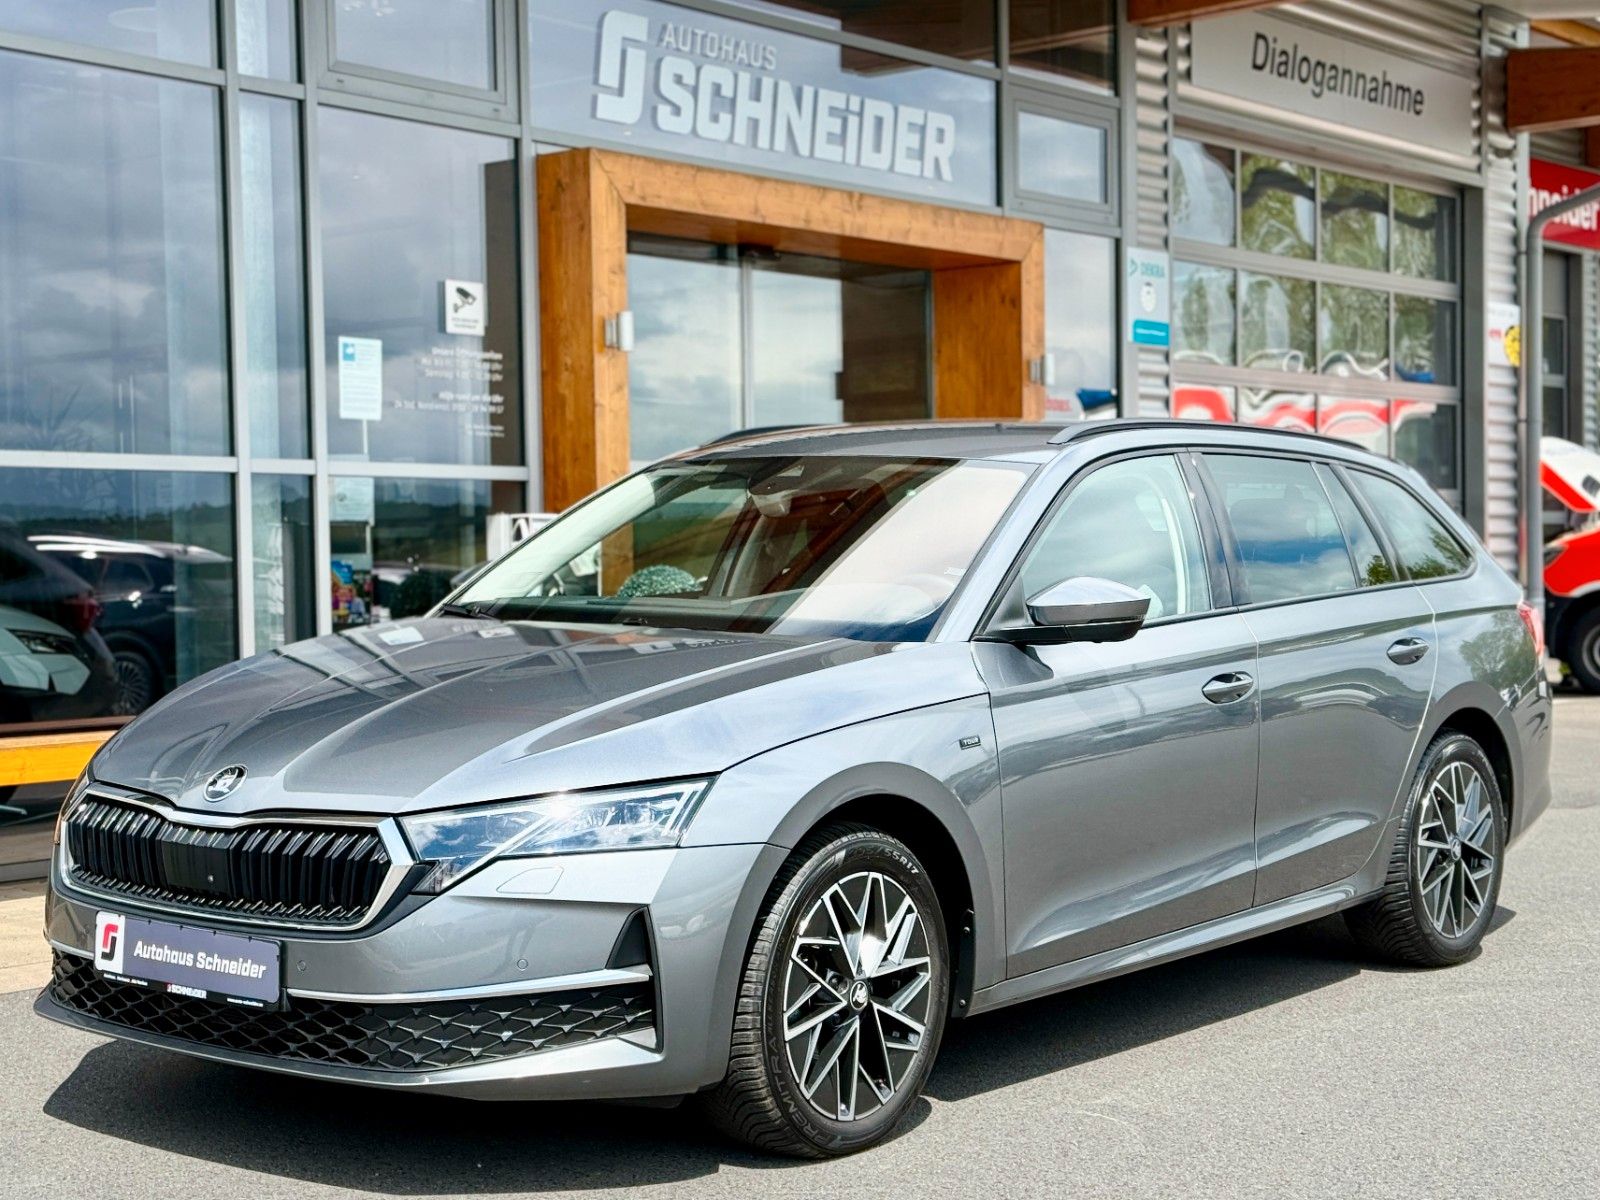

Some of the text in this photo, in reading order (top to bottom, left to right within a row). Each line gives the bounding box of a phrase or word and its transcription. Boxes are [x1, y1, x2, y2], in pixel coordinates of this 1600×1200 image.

[662, 22, 777, 70] AUTOHAUS
[1251, 32, 1425, 116] Dialogannahme
[134, 940, 267, 979] Autohaus Schneider
